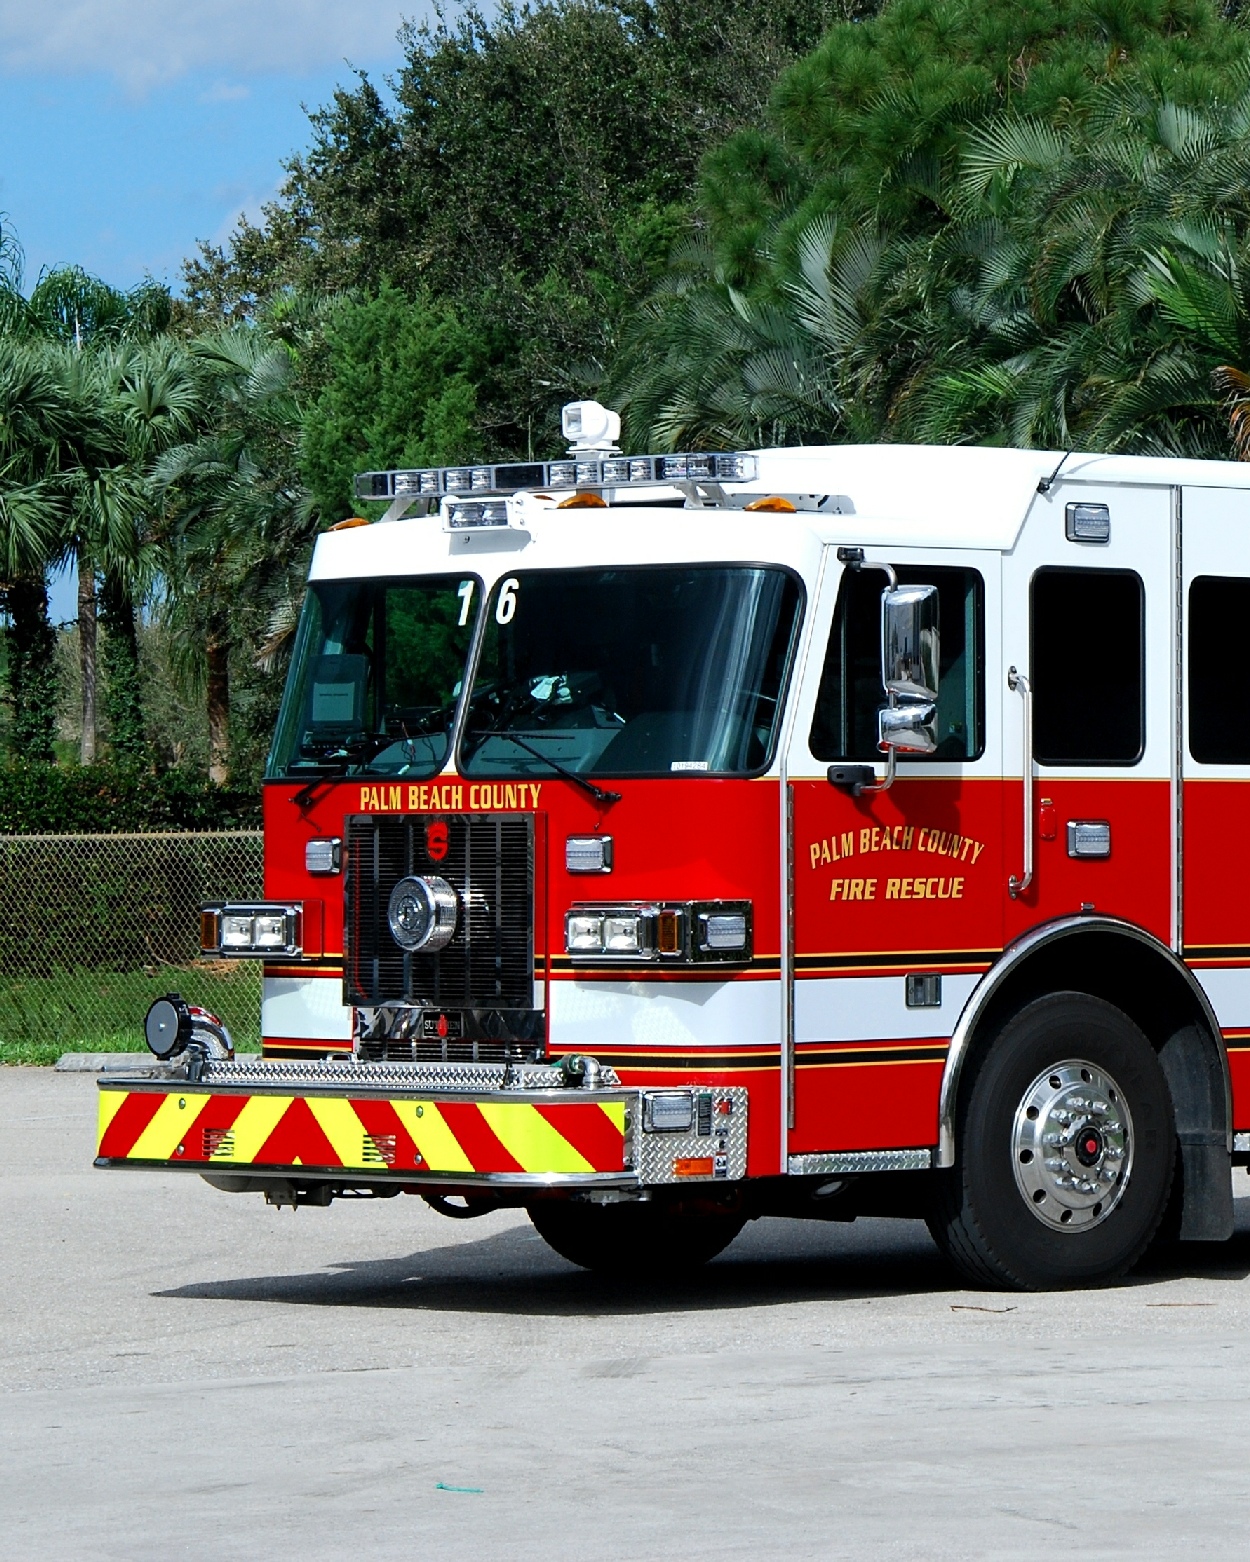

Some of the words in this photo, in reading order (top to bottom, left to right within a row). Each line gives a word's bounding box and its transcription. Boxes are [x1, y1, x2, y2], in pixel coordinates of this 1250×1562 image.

[360, 786, 402, 811] PALM
[408, 785, 463, 810] BEACH
[469, 783, 542, 809] COUNTY
[809, 831, 854, 870] PALM
[859, 825, 915, 854] BEACH
[917, 827, 985, 865] COUNTY
[829, 878, 878, 901] FIRE
[885, 877, 965, 900] RESCUE
